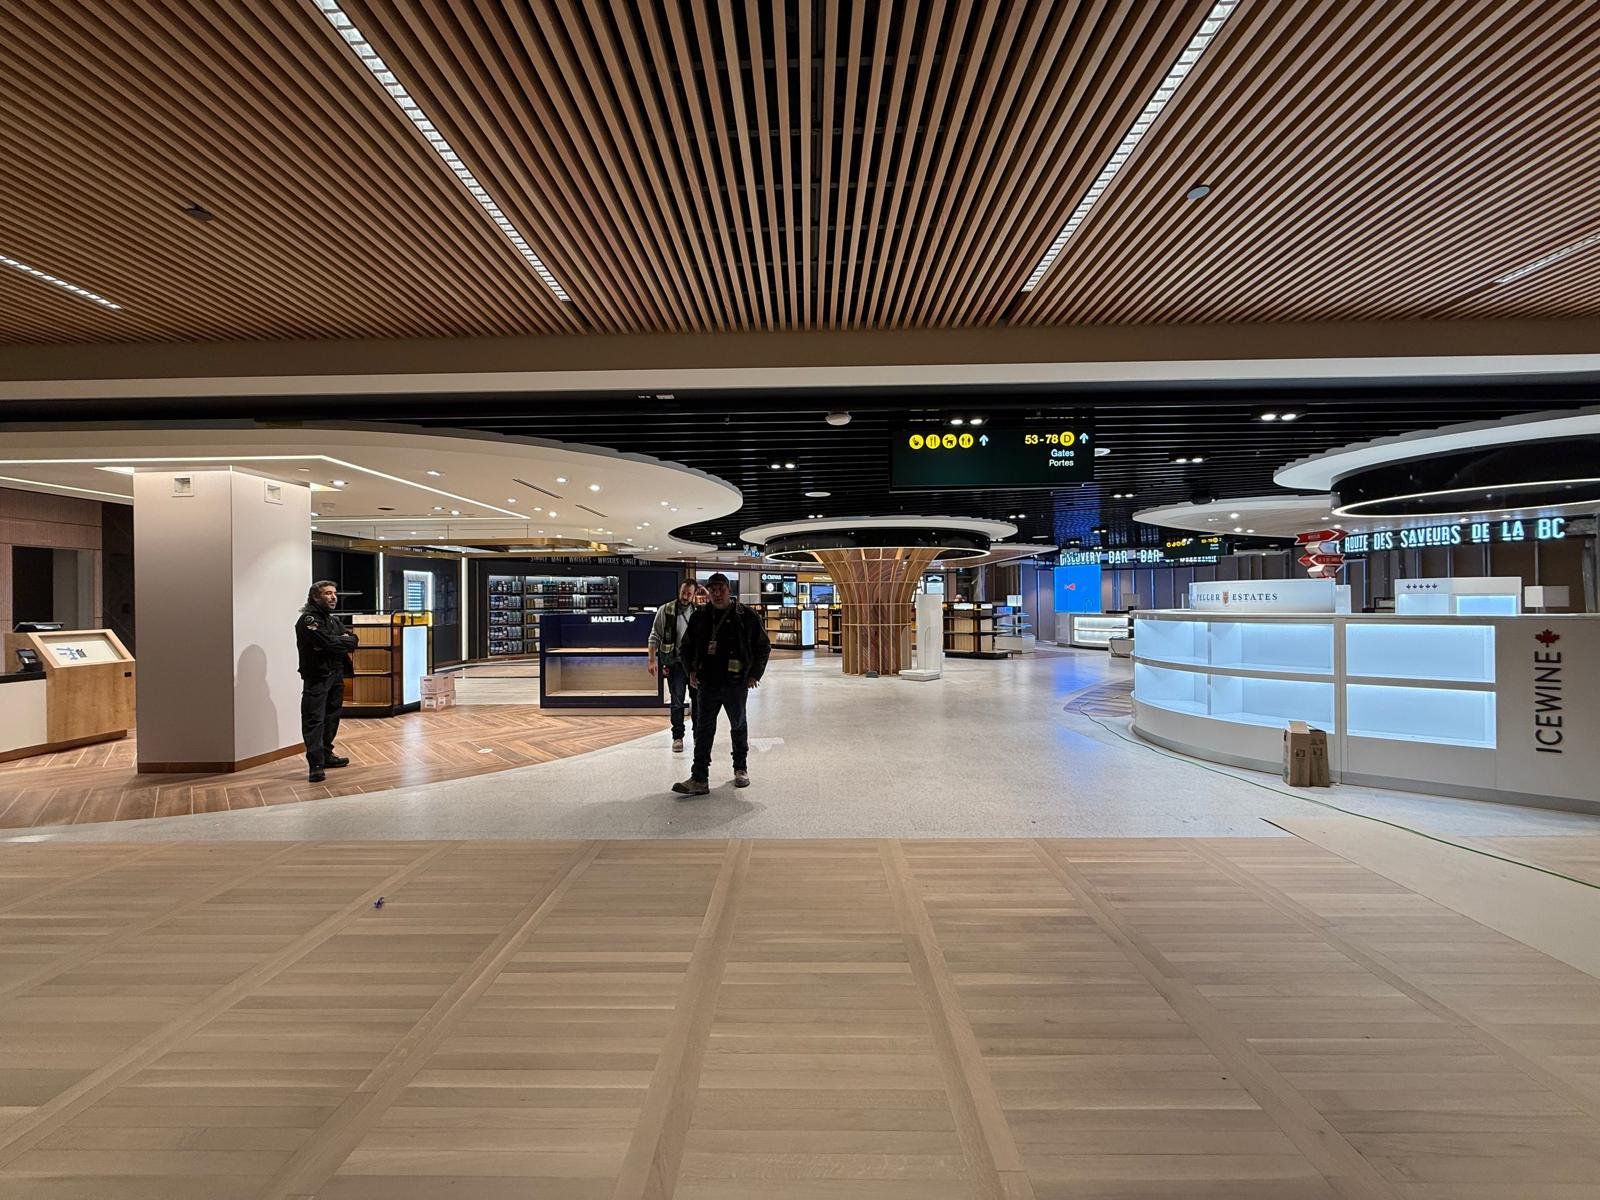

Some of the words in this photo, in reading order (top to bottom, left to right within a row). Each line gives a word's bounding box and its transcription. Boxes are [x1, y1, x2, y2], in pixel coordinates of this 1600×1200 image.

[1050, 449, 1075, 457] Gates
[1049, 459, 1074, 467] Portes
[1344, 534, 1369, 553] ROUTE
[1373, 531, 1393, 550] DES
[1400, 524, 1461, 549] SAVEURS
[1471, 522, 1490, 543] DE
[1502, 519, 1525, 541] LA
[1537, 517, 1566, 540] BC
[1060, 552, 1102, 566] DISCOVERY
[1108, 550, 1128, 564] BAR
[1140, 549, 1160, 563] BAR
[1232, 592, 1279, 602] ESTATES
[591, 615, 625, 623] MARTELL
[1534, 651, 1563, 754] ICEWINE
